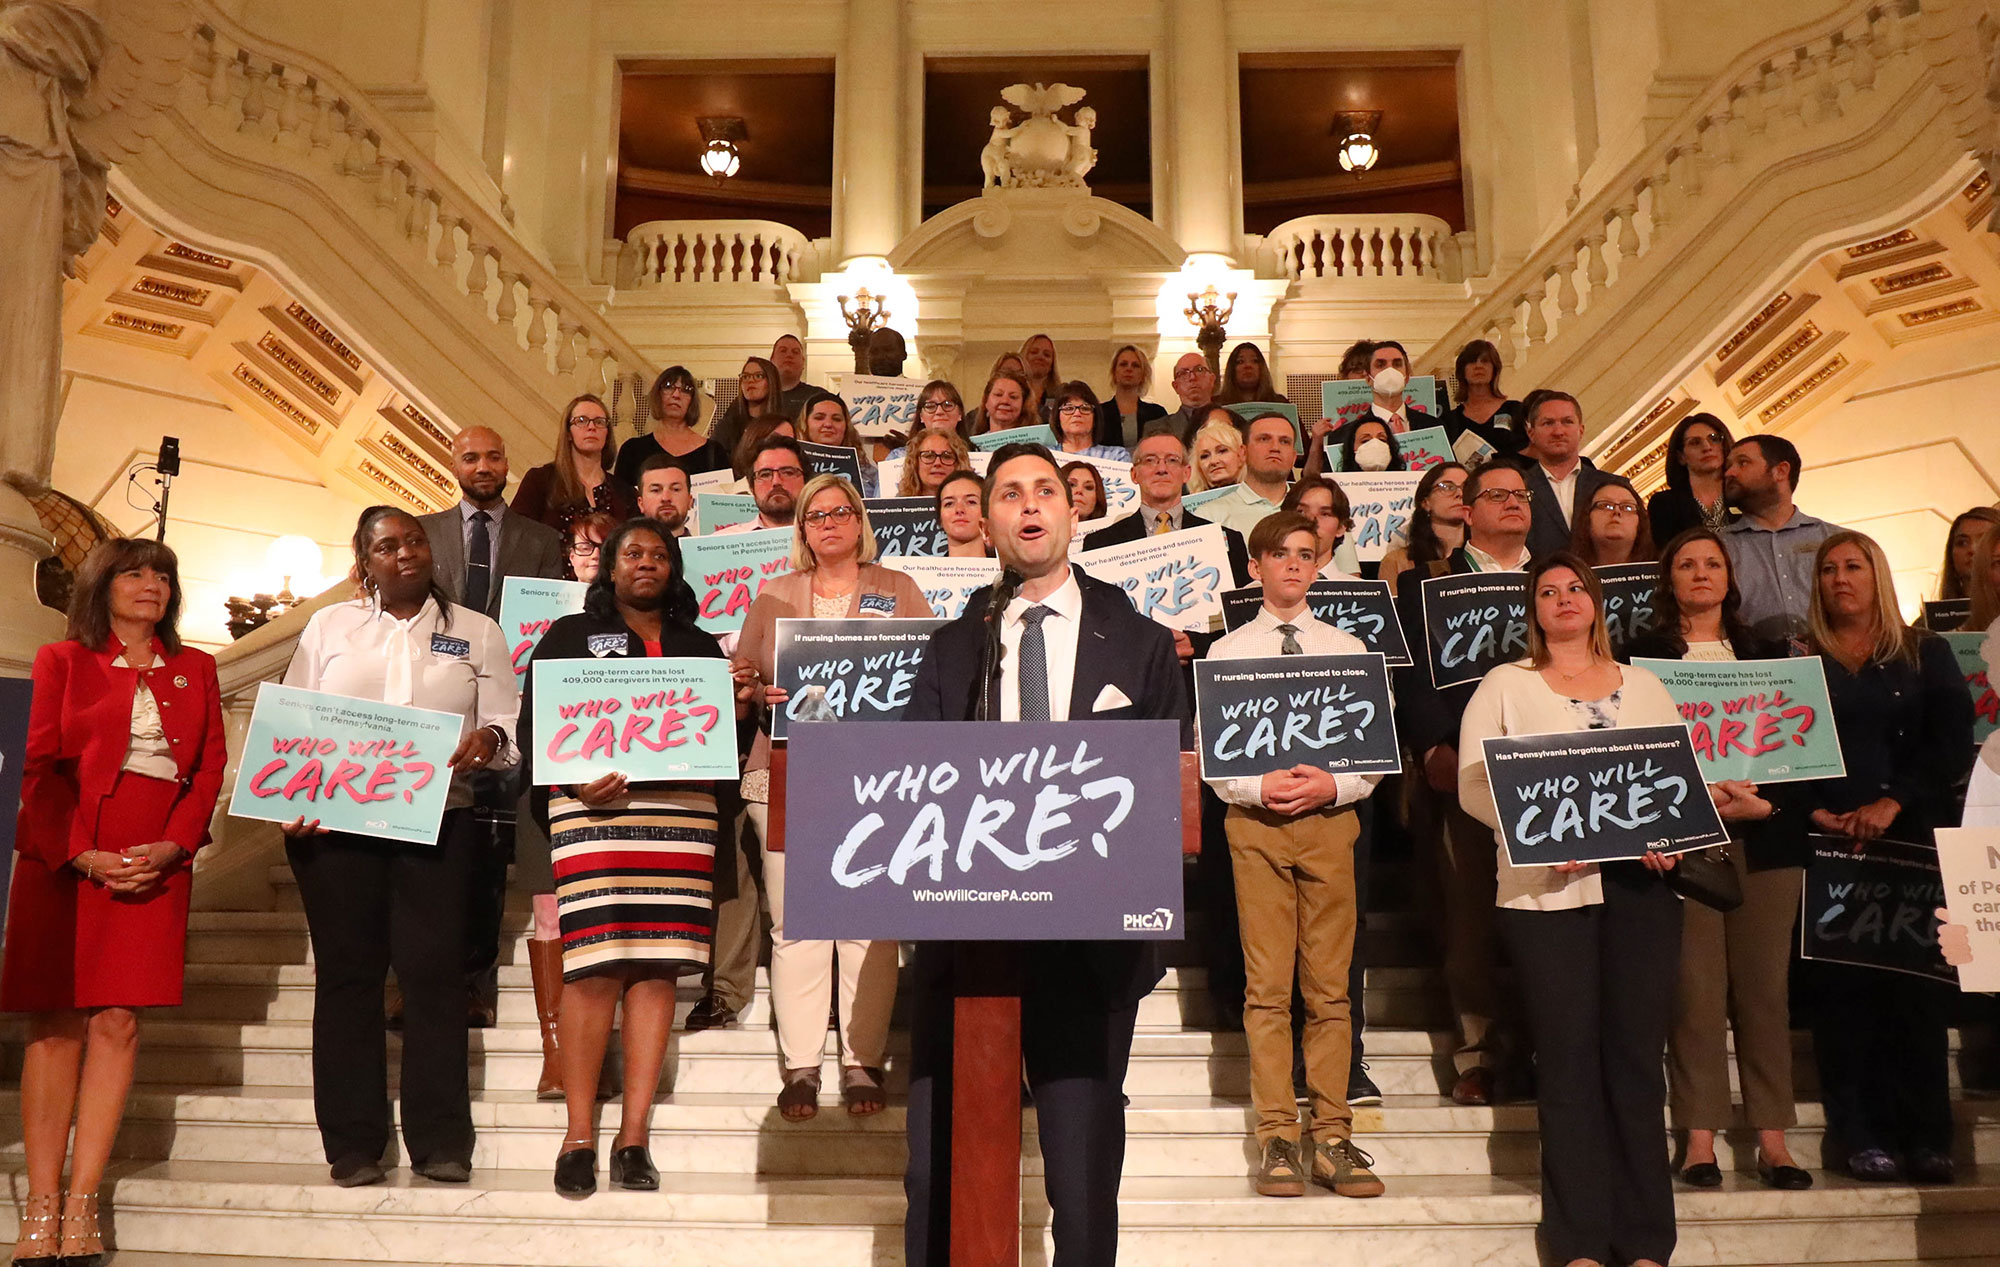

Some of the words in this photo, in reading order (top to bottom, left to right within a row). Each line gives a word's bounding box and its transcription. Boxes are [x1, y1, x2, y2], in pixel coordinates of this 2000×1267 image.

[853, 394, 886, 404] WHO
[890, 394, 917, 402] WIL
[1336, 402, 1371, 415] WHO
[849, 402, 917, 426] CARE
[1402, 448, 1430, 462] ILL
[812, 462, 840, 472] ILL
[1389, 496, 1415, 511] WI
[913, 518, 941, 533] WI
[697, 544, 725, 552] Seniors
[746, 540, 771, 548] access
[880, 530, 949, 557] ARE
[1084, 560, 1098, 568] Our
[1098, 552, 1136, 564] healthcare
[1137, 546, 1162, 556] heroes
[1162, 542, 1176, 550] and
[1177, 537, 1203, 547] seniors
[1120, 557, 1148, 566] deserve
[1149, 552, 1170, 562] more.
[1145, 554, 1202, 584] WILL
[704, 566, 754, 586] WHO
[760, 556, 794, 574] WI
[1600, 576, 1626, 584] homes
[520, 588, 550, 597] Seniors
[1143, 566, 1220, 619] RE?
[1440, 590, 1446, 598] If
[1446, 586, 1476, 597] nursing
[520, 618, 553, 636] WH
[1446, 606, 1499, 630] WHO
[794, 634, 802, 642] If
[802, 634, 834, 643] nursing
[834, 634, 862, 642] homes
[864, 634, 878, 642] are
[878, 634, 906, 642] forced
[907, 634, 916, 642] to
[918, 634, 930, 642] clo
[1440, 619, 1528, 668] CAR
[582, 669, 628, 678] Long-term
[651, 668, 667, 676] has
[668, 668, 685, 676] lost
[798, 658, 854, 682] WHO
[864, 648, 924, 672] WILL
[1214, 673, 1222, 682] If
[1222, 672, 1254, 683] nursing
[1255, 670, 1284, 680] homes
[1301, 669, 1330, 678] forced
[1332, 669, 1341, 677] to
[1342, 668, 1368, 677] close,
[1674, 670, 1716, 680] Long-term
[604, 676, 650, 684] caregivers
[1694, 680, 1738, 688] caregivers
[1768, 679, 1796, 687] years.
[558, 698, 621, 720] WHO
[631, 688, 700, 710] WILL
[785, 669, 919, 721] CARE
[1221, 698, 1280, 720] WHO
[1289, 684, 1356, 707] WILL
[1676, 702, 1714, 720] HO
[1722, 690, 1792, 714] WILL
[278, 698, 314, 712] Seniors
[316, 704, 340, 714] can't
[340, 710, 373, 720] access
[374, 713, 418, 728] long-term
[420, 722, 441, 732] care
[320, 714, 330, 722] in
[330, 716, 394, 734] Pennsylvania.
[546, 704, 718, 764] CARE?
[1214, 700, 1376, 762] CARE?
[1691, 706, 1816, 762] ARE?
[273, 736, 338, 758] WHO
[348, 739, 420, 758] WILL
[1496, 752, 1512, 762] Has
[1513, 746, 1568, 761] Pennsylvania
[1568, 744, 1608, 758] forgotten
[1608, 742, 1632, 752] about
[1633, 742, 1644, 750] its
[1646, 740, 1681, 750] seniors?
[250, 758, 434, 804] CARE?
[854, 762, 960, 805] WHO
[979, 740, 1103, 788] WILL
[1516, 776, 1580, 802] WHO
[1589, 758, 1664, 788] WILL
[1515, 776, 1688, 846] CARE?
[831, 776, 1135, 888] CARE?
[1816, 850, 1832, 858] Has
[912, 890, 1053, 902] WhoWillCarePA.com
[1828, 882, 1892, 900] WHO
[1903, 884, 1946, 900] WIL
[1959, 881, 1976, 894] of
[1124, 914, 1165, 928] PHCA
[1815, 902, 1940, 948] CAR
